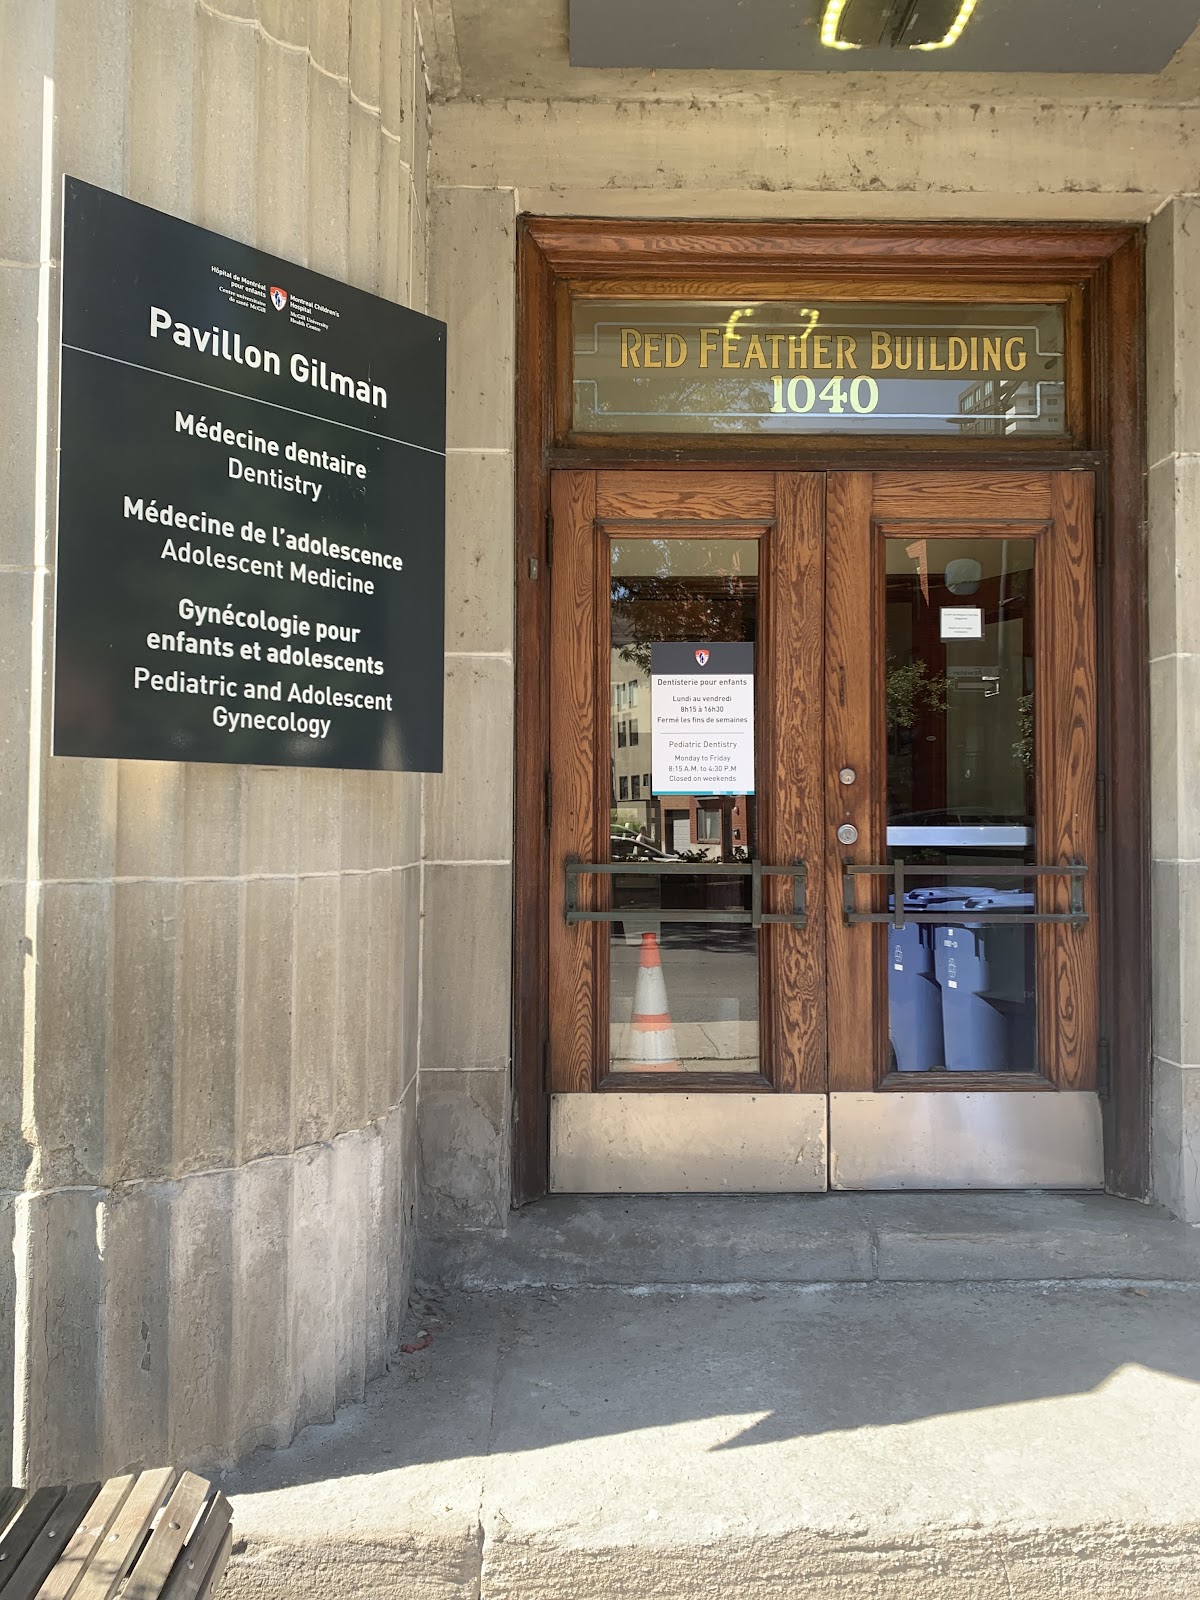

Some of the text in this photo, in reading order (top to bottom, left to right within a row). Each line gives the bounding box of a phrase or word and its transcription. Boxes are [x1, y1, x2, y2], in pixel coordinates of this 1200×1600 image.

[211, 266, 232, 279] Hôpital
[242, 276, 266, 291] Montréal
[219, 286, 236, 296] Centre
[245, 286, 266, 298] enfants
[236, 299, 248, 307] santé
[250, 303, 266, 313] McGill
[290, 294, 340, 318] Montreal Children's
[290, 302, 311, 314] Hospital
[290, 311, 329, 330] McGill University
[290, 317, 321, 332] Health Centre
[149, 305, 388, 409] Pavillon Gilman
[619, 327, 689, 369] RED
[769, 375, 879, 413] 1040
[175, 410, 367, 479] Médecine dentaire
[228, 457, 323, 502] Dentistry
[123, 495, 404, 572] Médecine de l'adolescence
[160, 538, 375, 595] Adolescent Medicine
[178, 598, 361, 643] Gynécologie pour
[146, 631, 384, 675] enfants et adolescents
[134, 667, 393, 712] Pediatric and Adolescent
[657, 678, 747, 687] Dentisterie pour enfants
[212, 706, 331, 739] Gynecology
[703, 741, 737, 749] Dentistry
